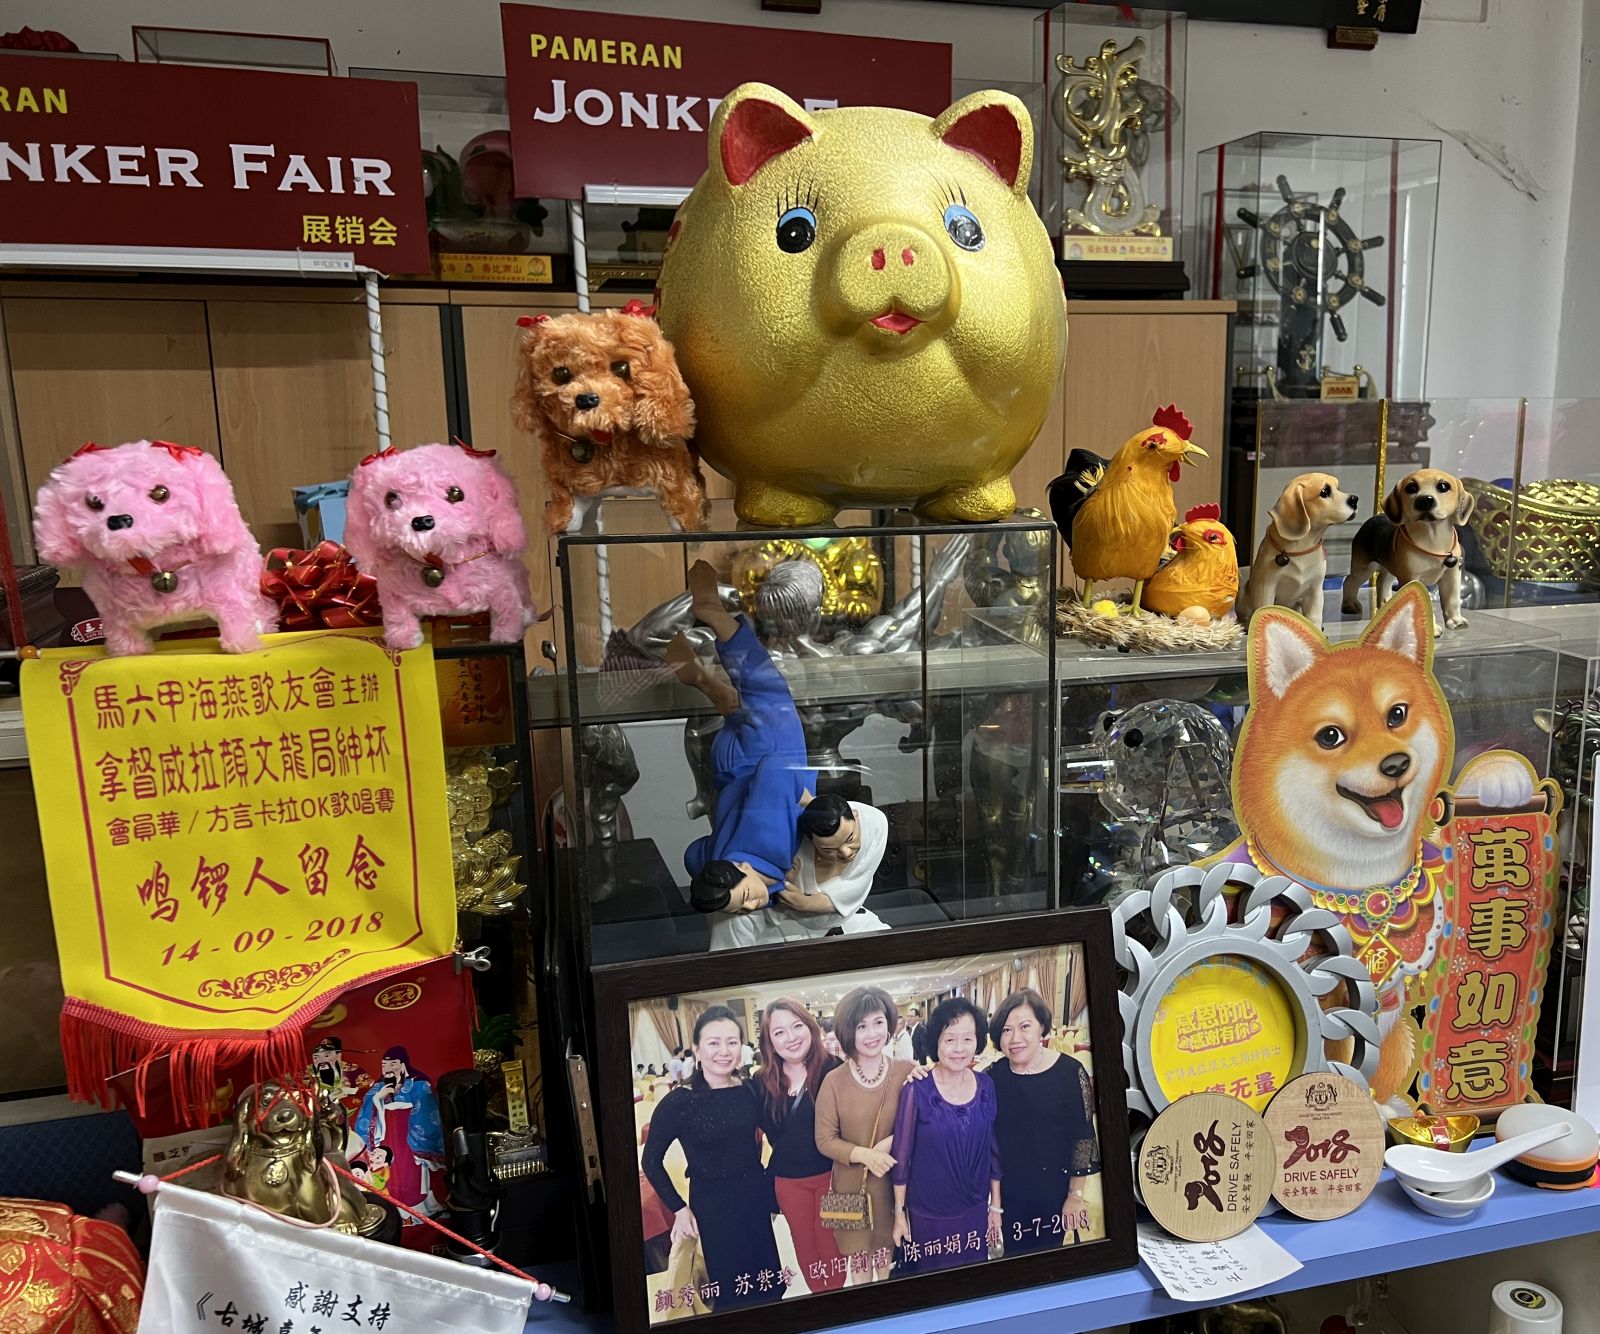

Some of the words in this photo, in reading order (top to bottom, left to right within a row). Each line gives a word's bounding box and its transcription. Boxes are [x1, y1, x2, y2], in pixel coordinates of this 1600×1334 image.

[530, 33, 683, 70] PAMERAN
[534, 79, 722, 132] JONK
[0, 141, 203, 188] NKER
[229, 144, 396, 197] FAIR
[302, 214, 398, 248] 展销会
[94, 666, 380, 730] 馬六甲海燕歌友會主辦
[136, 834, 387, 923] 鸣锣人留念
[1446, 827, 1531, 1100] 萬事如意
[1229, 1121, 1242, 1170] SAFELY
[1227, 1170, 1240, 1212] DRIVE
[1284, 1170, 1317, 1183] DRIVE
[1319, 1168, 1359, 1181] SAFELY
[1327, 1183, 1362, 1194] 平安回家
[654, 1281, 720, 1312] 颜秀丽
[734, 1265, 798, 1297] 苏紫玲
[903, 1223, 1001, 1263] 陈丽娟局绅
[1012, 1209, 1089, 1241] 3-7-2018
[285, 1281, 391, 1331] 感謝支持
